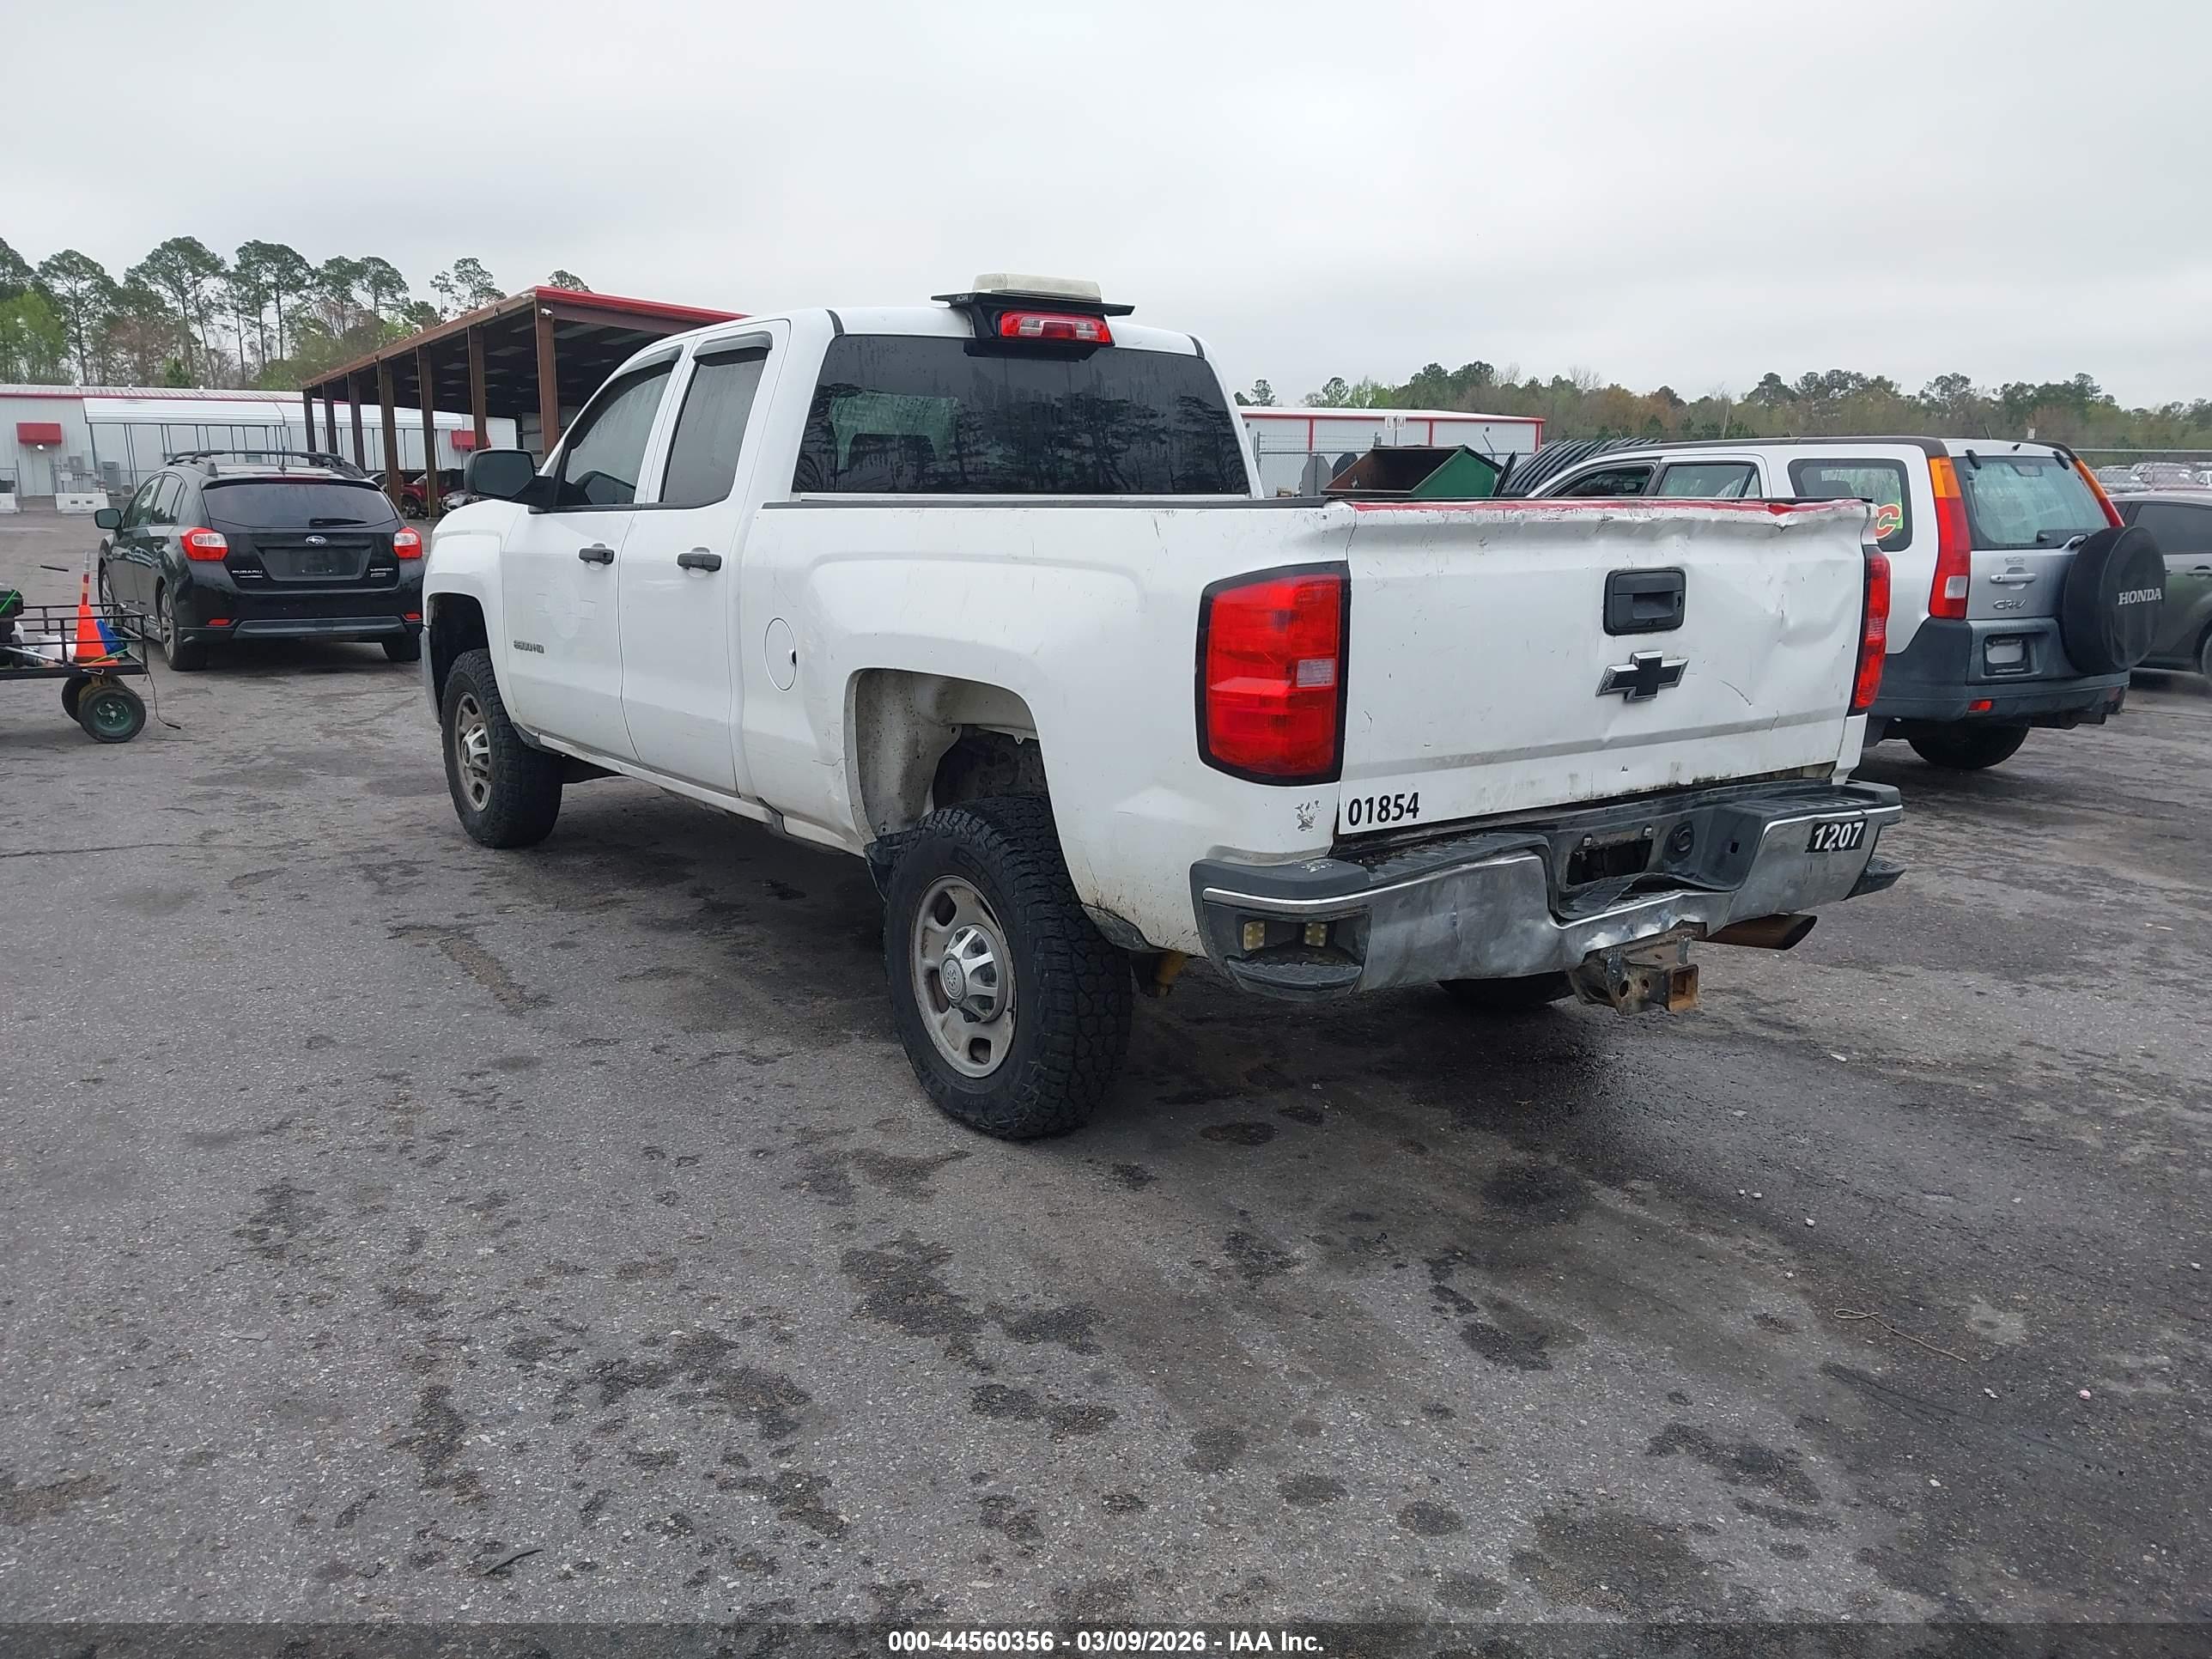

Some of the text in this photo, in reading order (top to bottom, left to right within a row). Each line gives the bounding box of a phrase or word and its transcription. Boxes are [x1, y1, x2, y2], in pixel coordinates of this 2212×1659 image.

[1993, 598, 2027, 611] CR-V
[2118, 587, 2163, 605] HONDA
[1347, 792, 1420, 827] 01854
[1814, 821, 1864, 850] 1207
